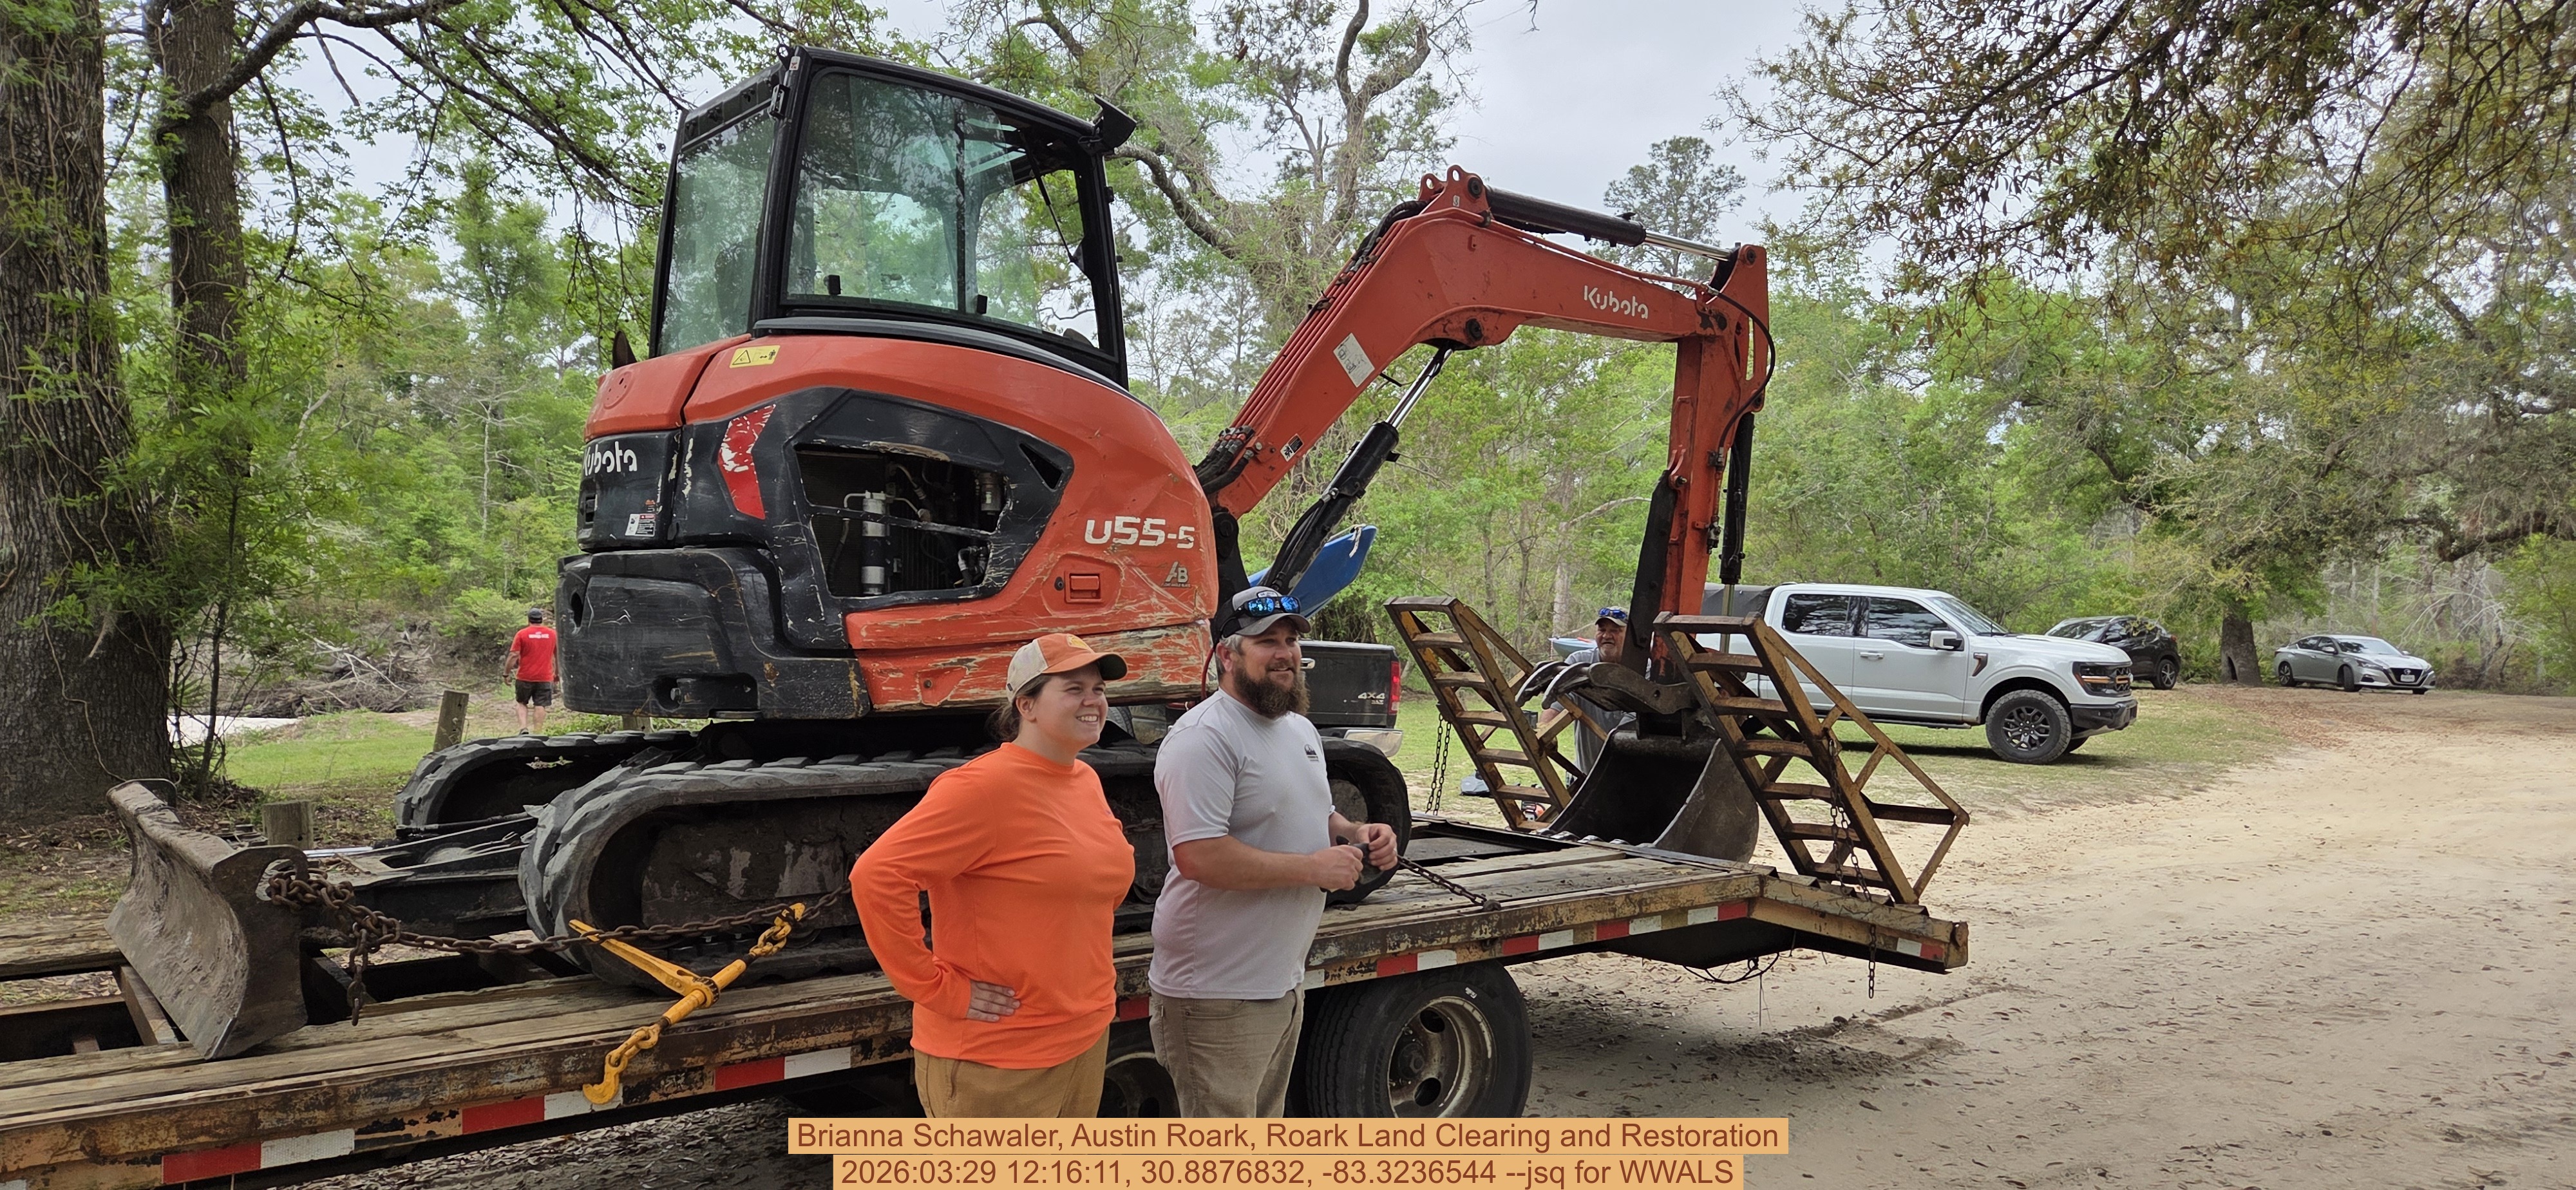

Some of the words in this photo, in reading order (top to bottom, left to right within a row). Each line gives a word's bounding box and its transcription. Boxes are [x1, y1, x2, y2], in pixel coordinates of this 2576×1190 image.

[1584, 285, 1649, 319] Kubota
[1084, 516, 1195, 549] U55-5
[1165, 561, 1188, 583] AB
